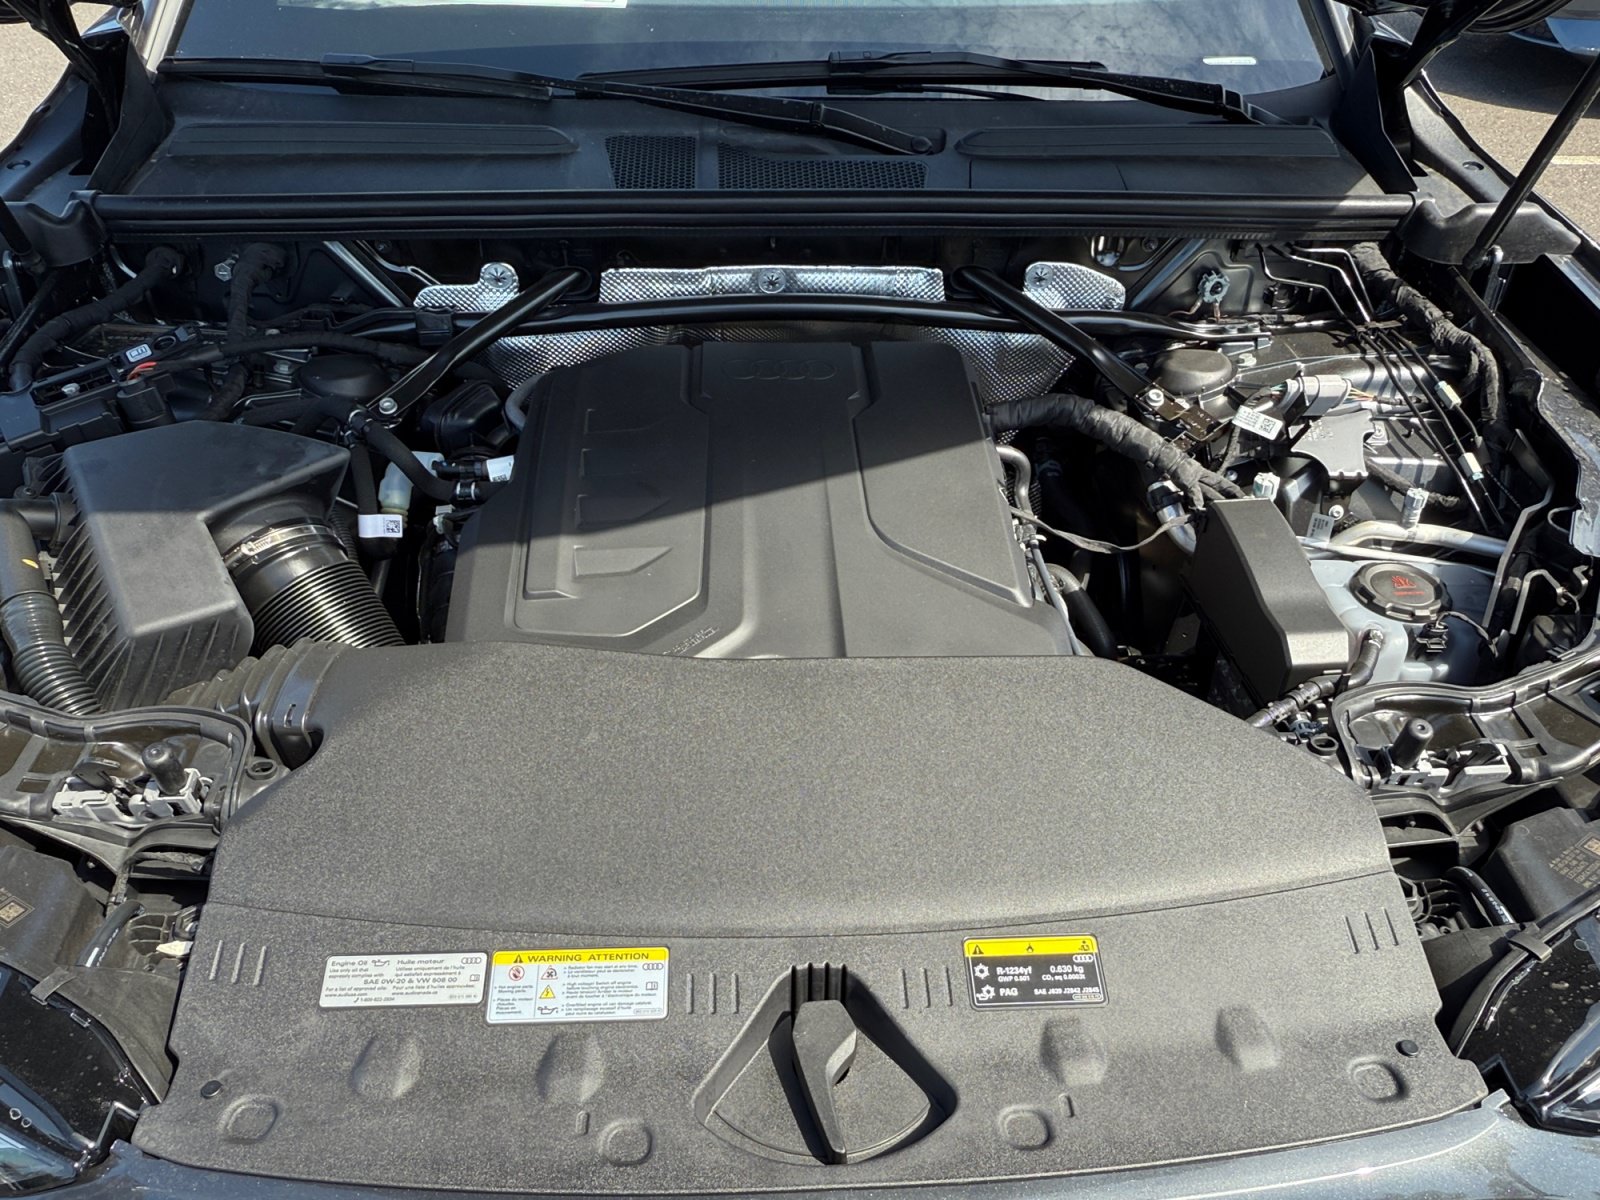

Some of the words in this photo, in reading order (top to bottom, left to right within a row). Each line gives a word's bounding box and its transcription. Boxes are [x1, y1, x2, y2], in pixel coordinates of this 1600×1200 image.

[527, 954, 582, 962] WARNING
[588, 952, 650, 961] ATTENTION
[996, 966, 1032, 975] R-1234yf
[1074, 965, 1084, 973] kg
[1000, 987, 1018, 996] PAG
